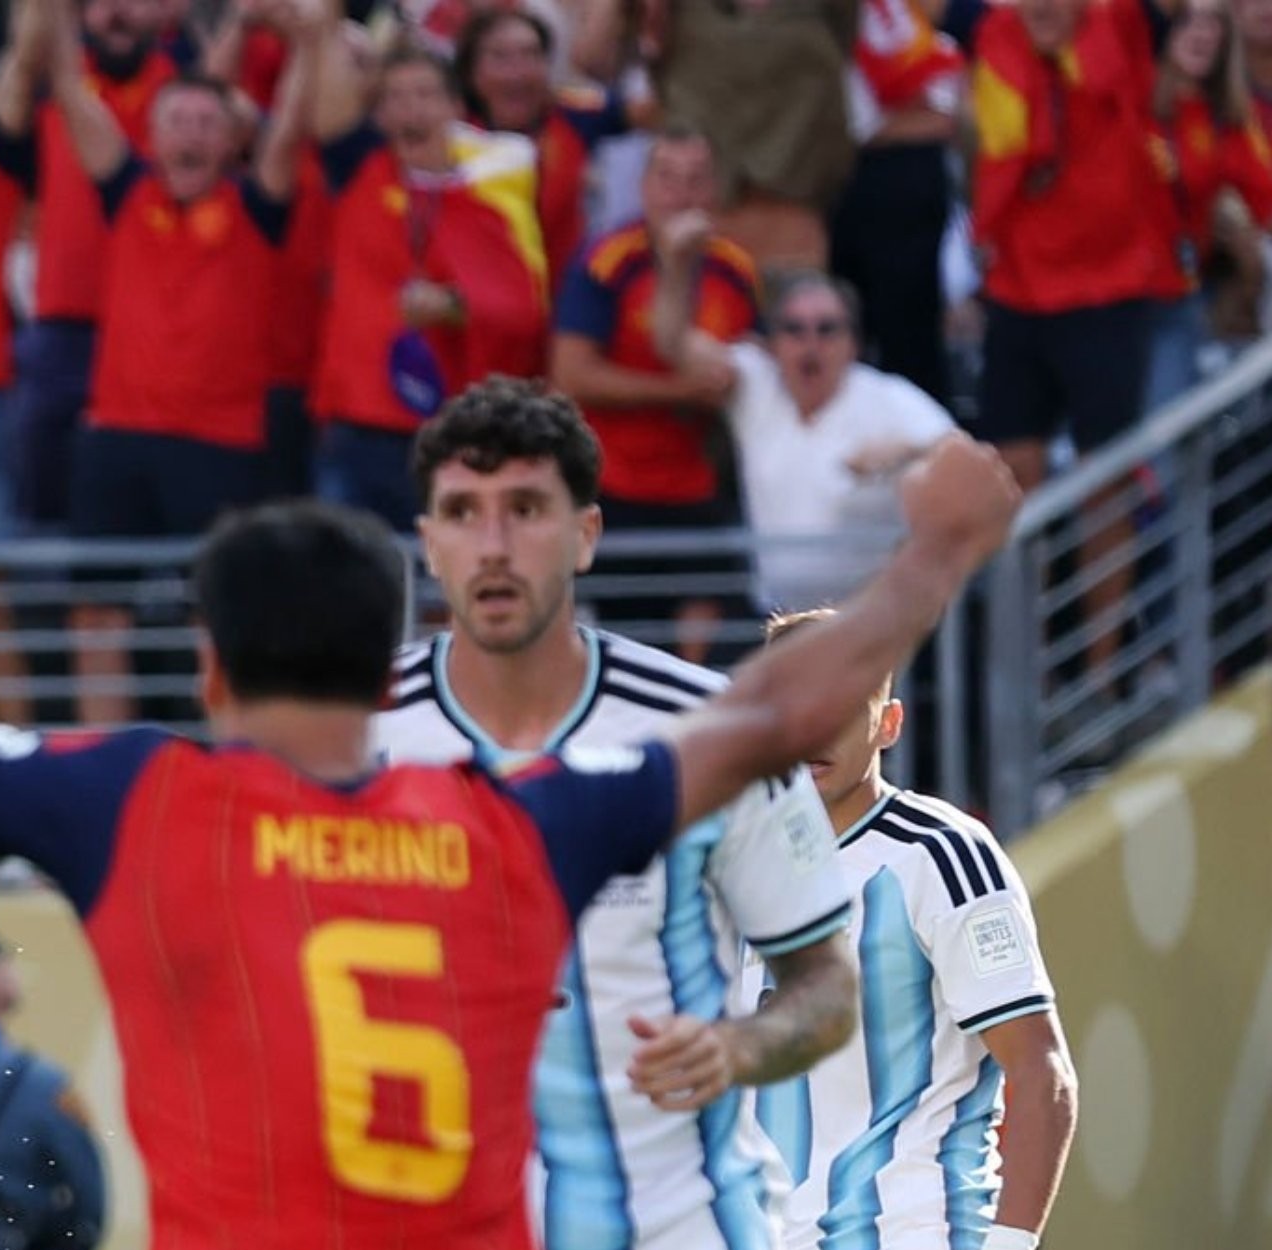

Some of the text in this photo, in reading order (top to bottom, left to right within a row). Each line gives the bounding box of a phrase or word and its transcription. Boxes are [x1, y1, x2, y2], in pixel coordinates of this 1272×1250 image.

[254, 814, 471, 889] MERINO
[976, 925, 1012, 946] UNITES
[301, 917, 472, 1205] 6
